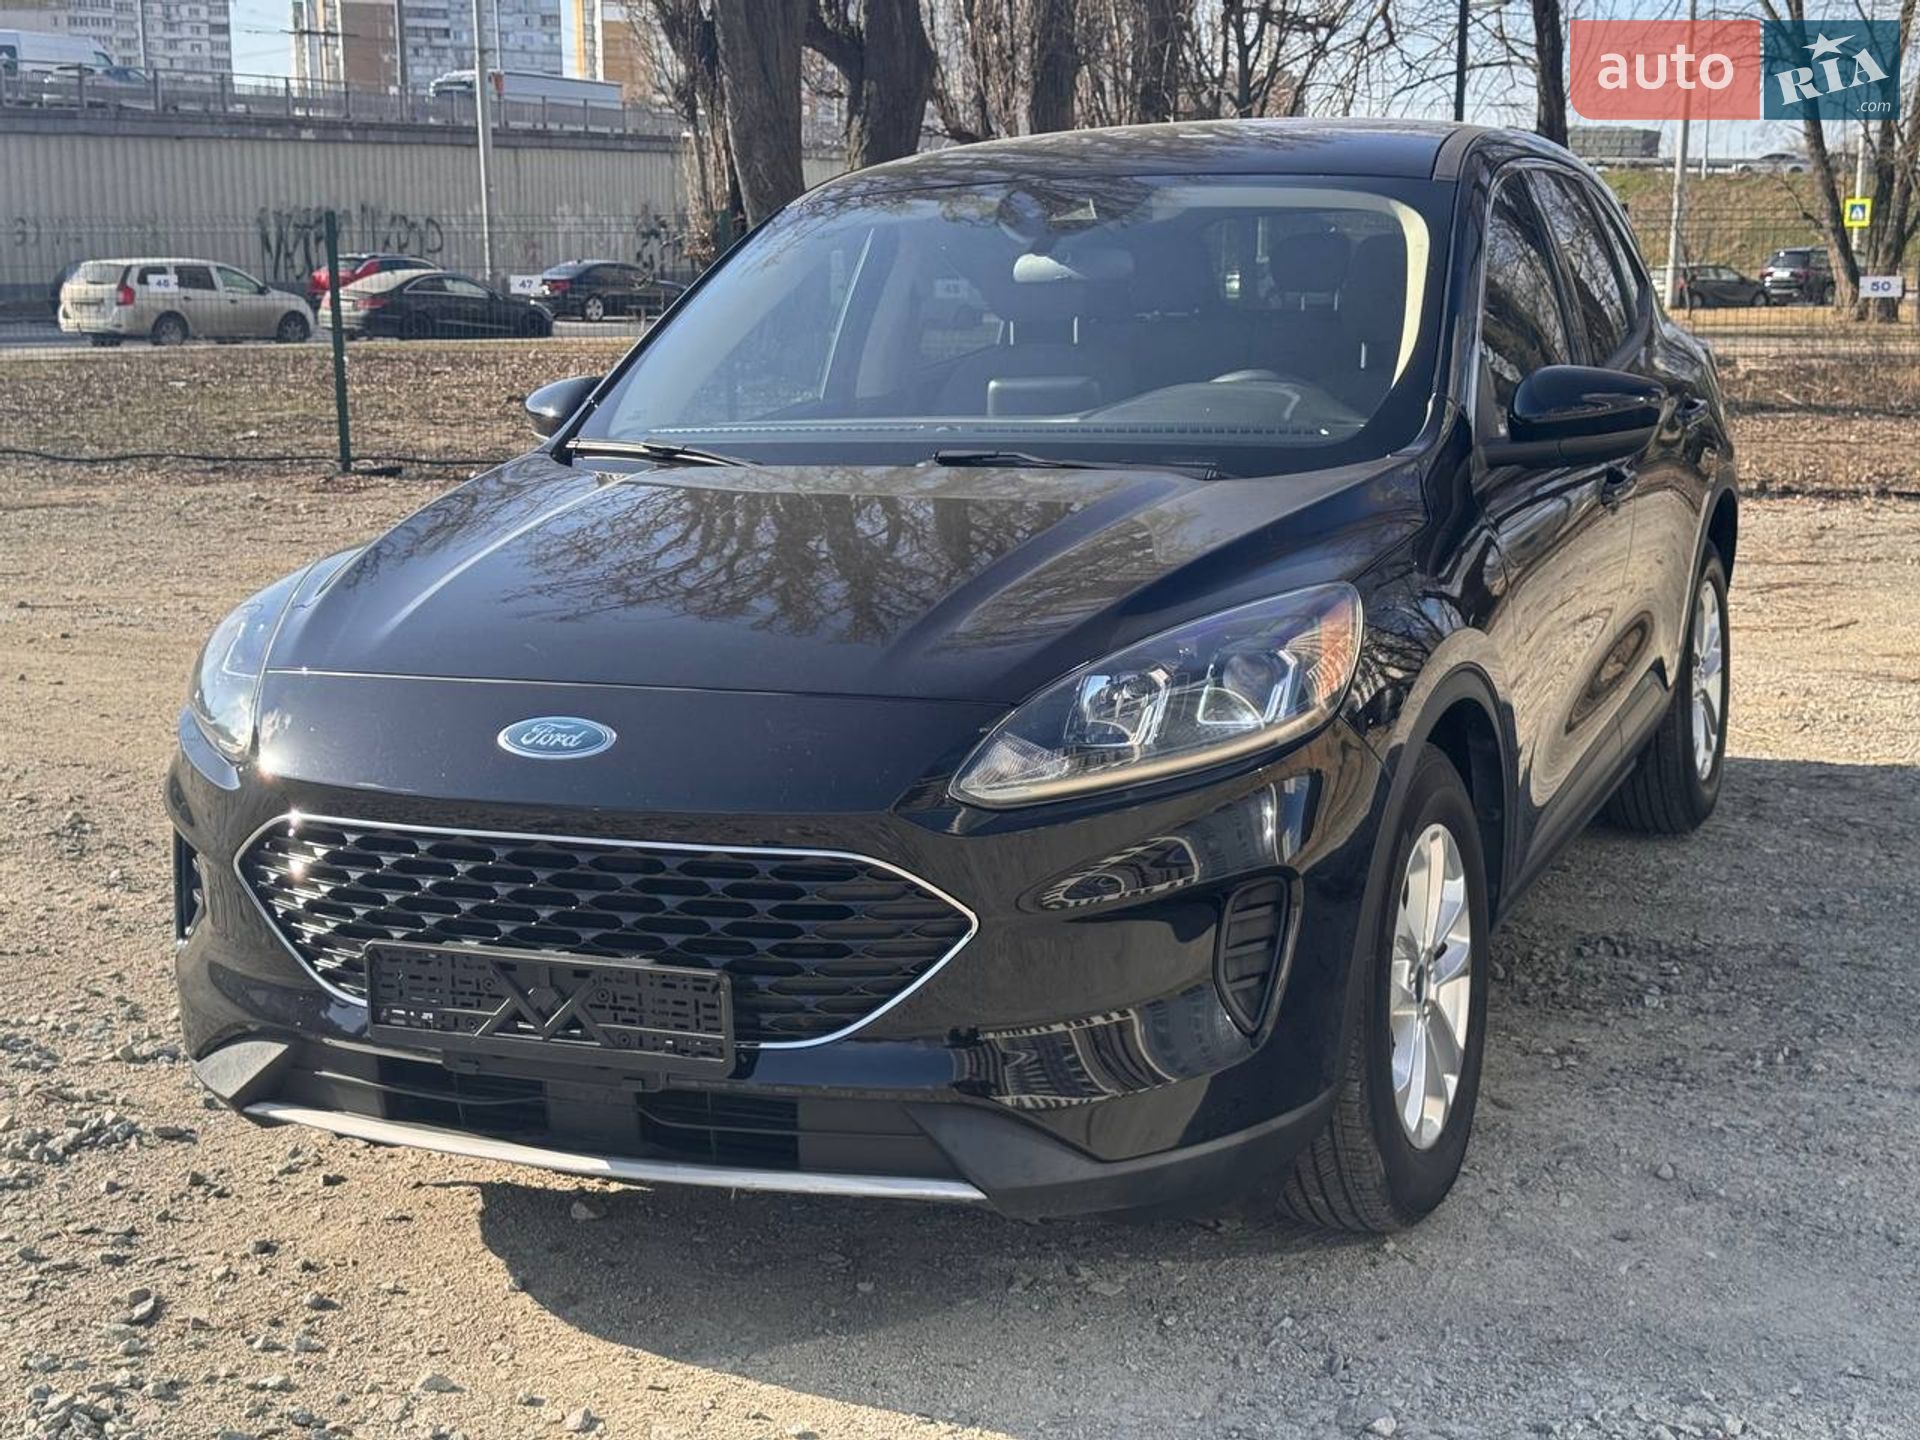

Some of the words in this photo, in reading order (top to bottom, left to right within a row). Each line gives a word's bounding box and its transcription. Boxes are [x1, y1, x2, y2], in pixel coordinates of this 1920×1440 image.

[519, 279, 534, 289] 47
[1871, 281, 1892, 292] 50
[520, 721, 589, 747] Ford
